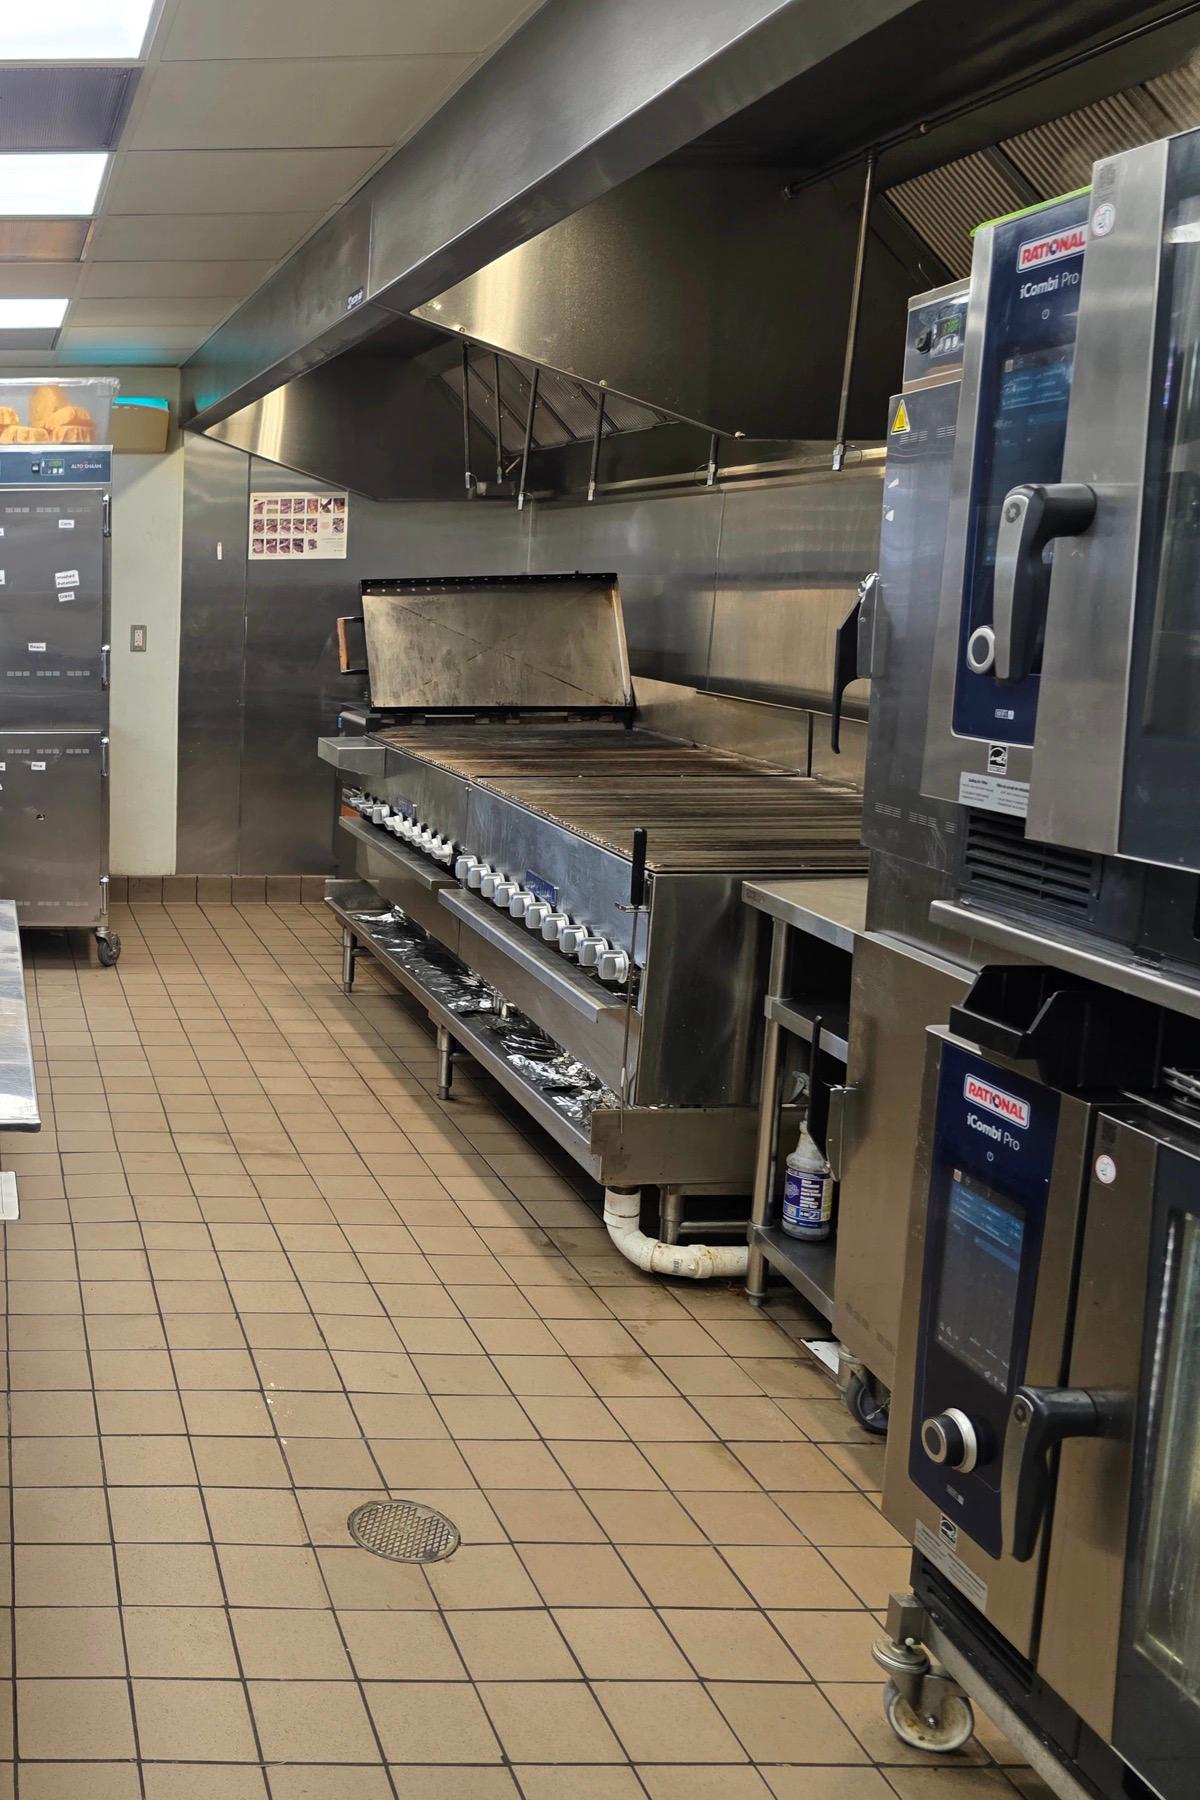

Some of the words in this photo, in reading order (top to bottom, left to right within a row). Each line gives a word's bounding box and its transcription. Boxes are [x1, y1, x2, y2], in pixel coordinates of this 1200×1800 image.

[1022, 231, 1086, 265] RATIONAL
[1020, 275, 1060, 299] iCombi
[1061, 271, 1080, 287] Pro
[968, 1082, 1025, 1121] RATIONAL
[967, 1113, 1002, 1142] iCombi
[1003, 1131, 1021, 1151] Pro
